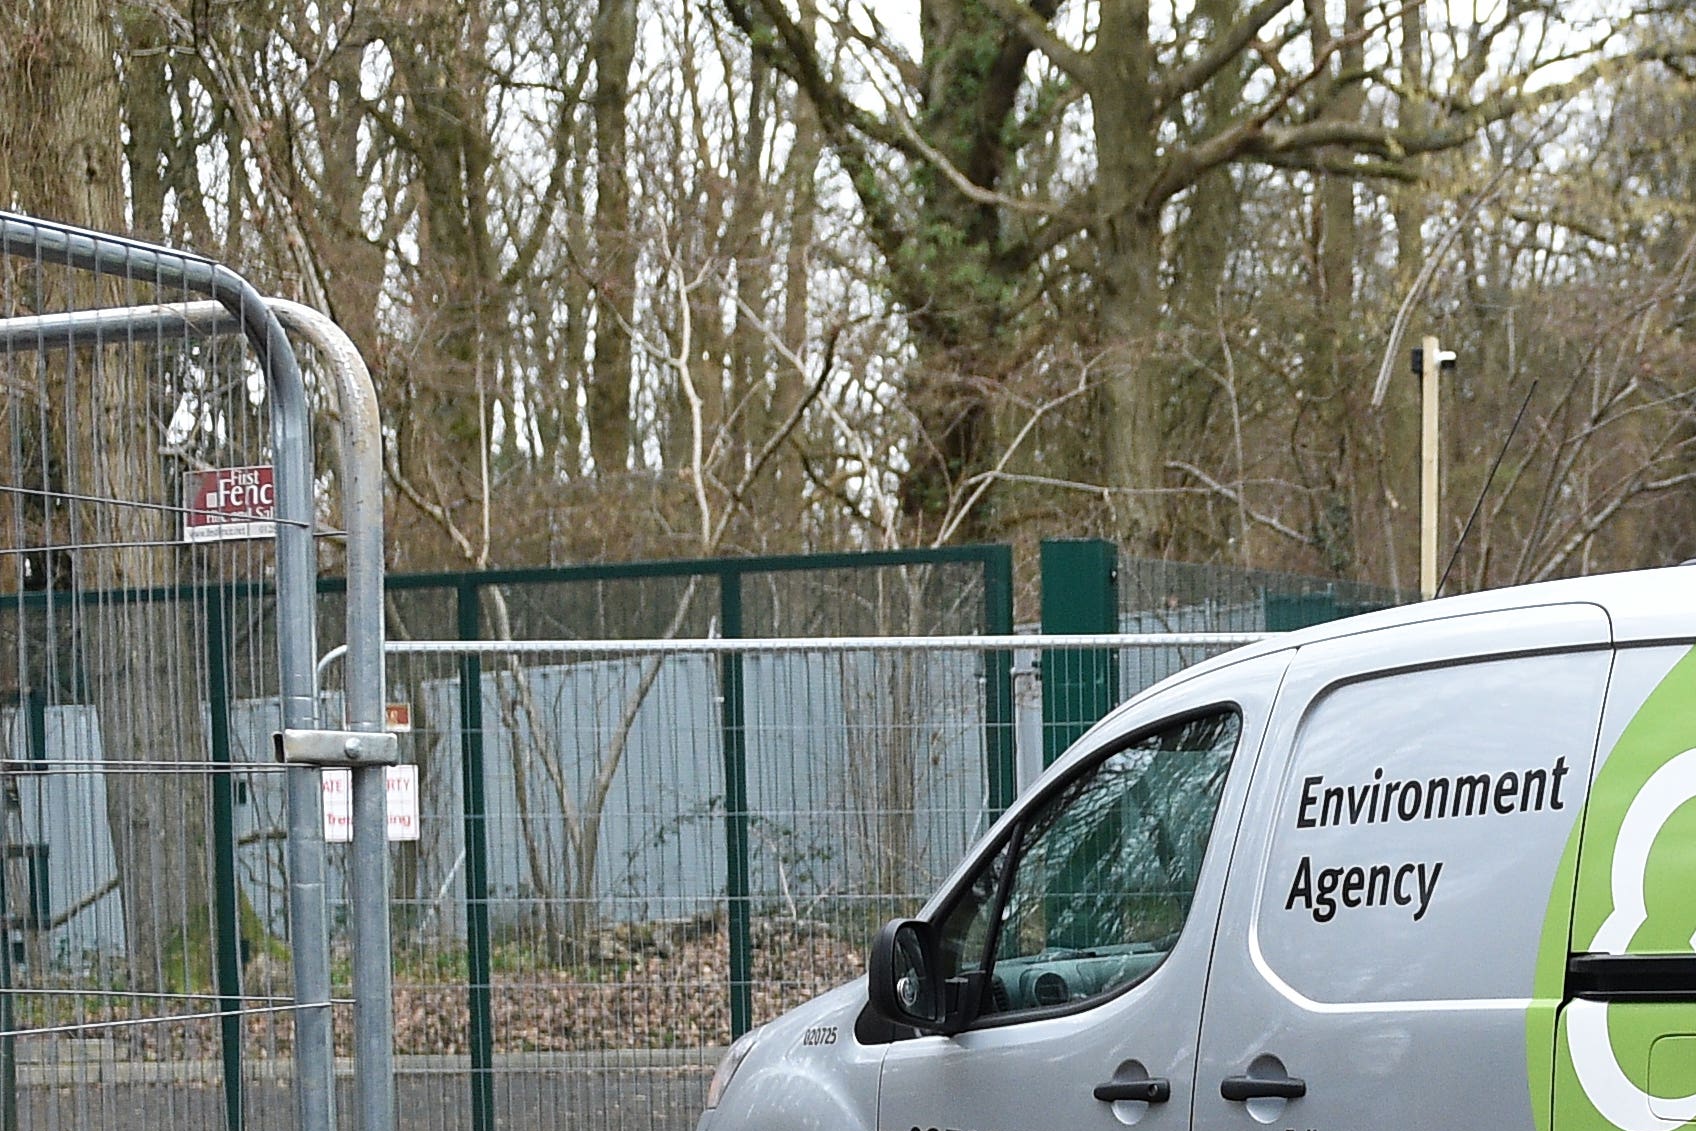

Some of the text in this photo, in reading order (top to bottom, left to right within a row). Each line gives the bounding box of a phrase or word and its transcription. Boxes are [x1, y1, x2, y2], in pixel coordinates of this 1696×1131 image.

[231, 470, 259, 485] First
[219, 478, 273, 507] Fenc
[1296, 756, 1569, 829] Environment
[1285, 856, 1443, 922] Agency
[803, 1027, 838, 1046] 020725
